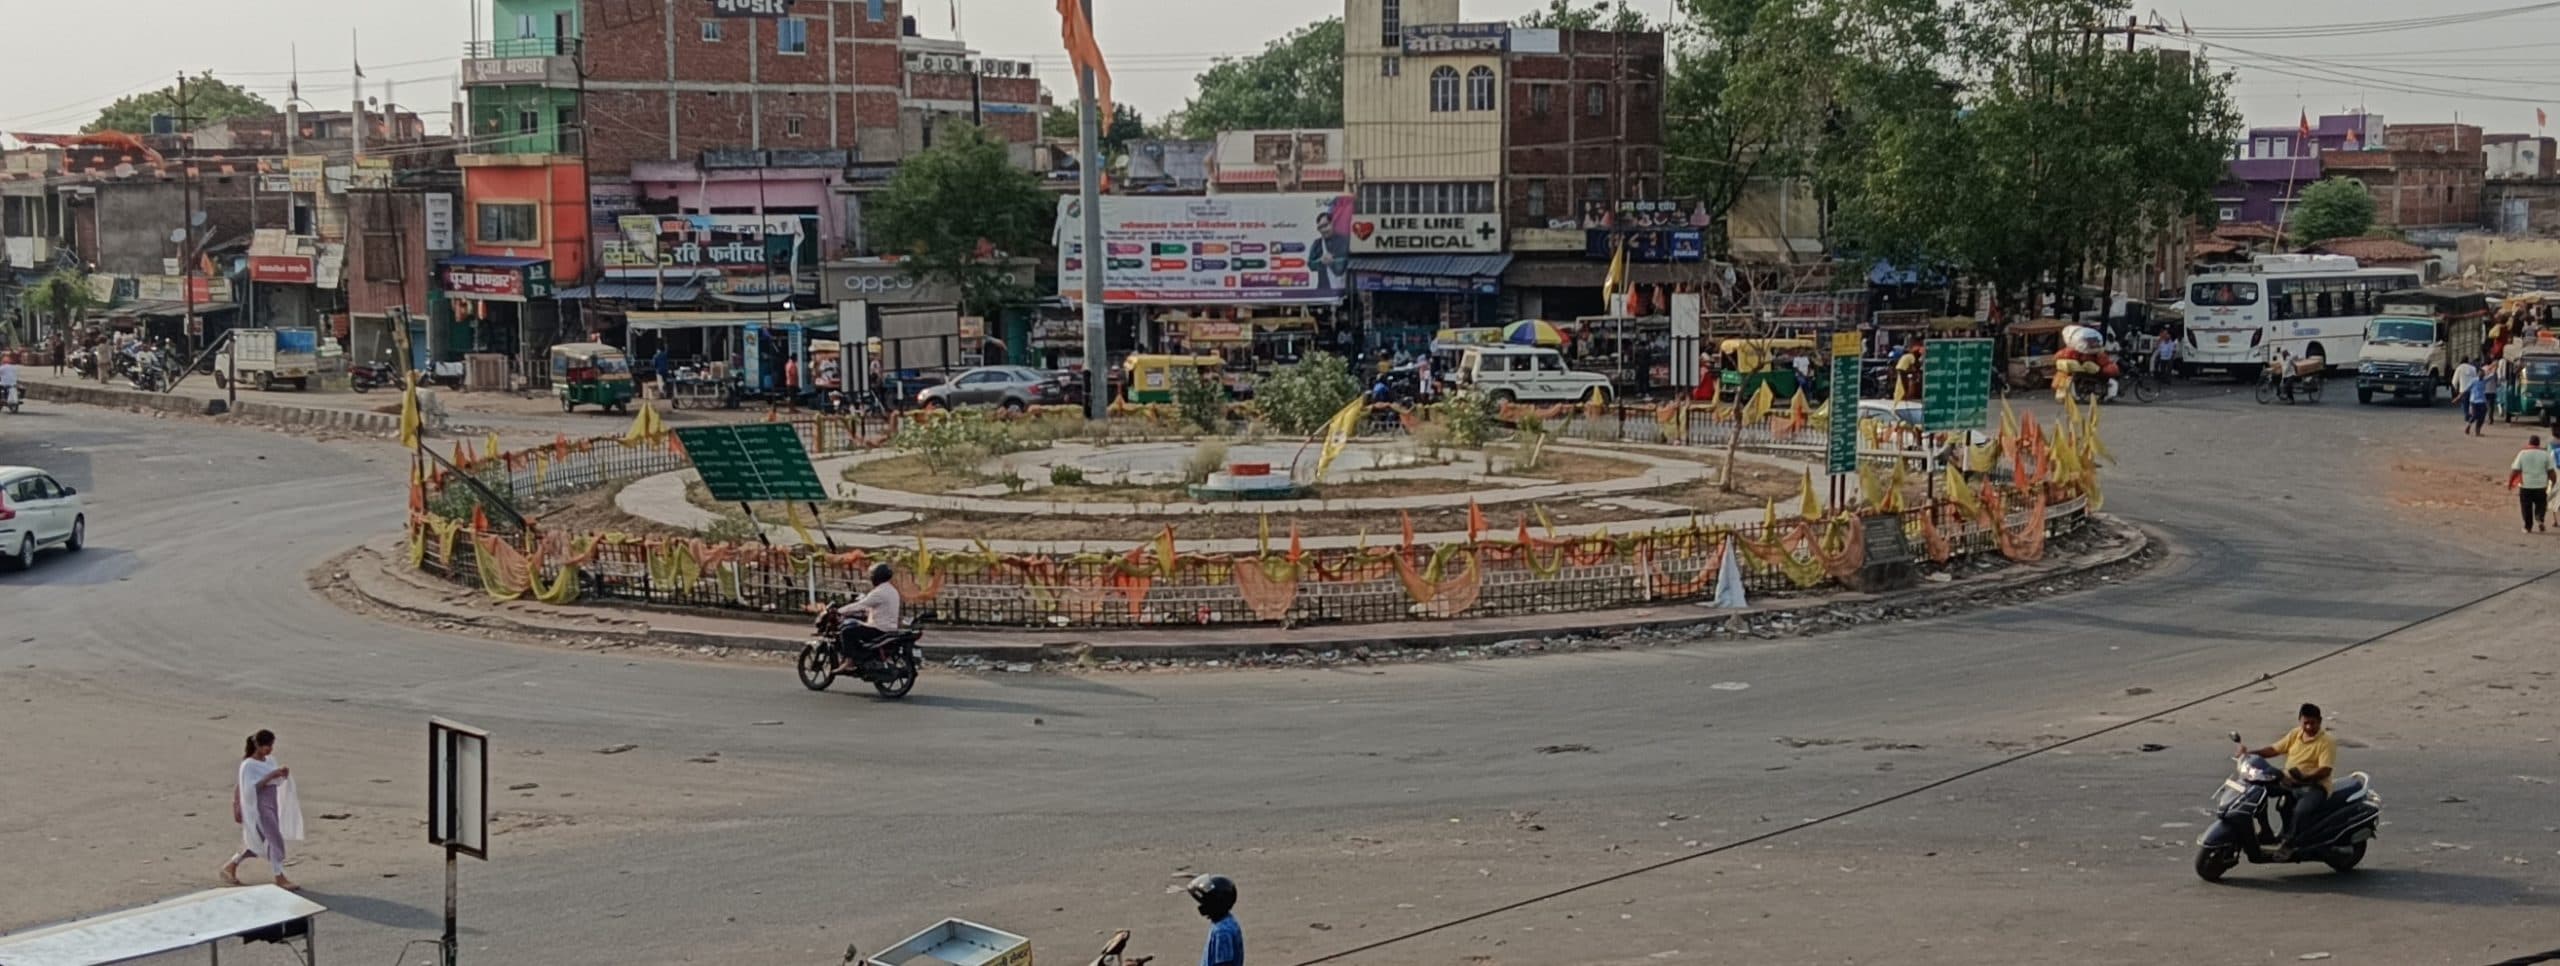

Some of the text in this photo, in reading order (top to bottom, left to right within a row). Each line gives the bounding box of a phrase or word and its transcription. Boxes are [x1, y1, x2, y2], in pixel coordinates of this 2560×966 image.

[475, 60, 501, 81] पूजा
[1380, 217, 1465, 229] LIFE LINE
[1375, 235, 1474, 249] MEDICAL
[673, 242, 701, 263] रवि
[707, 241, 765, 263] फर्नीचर
[450, 272, 510, 290] पूजा भण्डार
